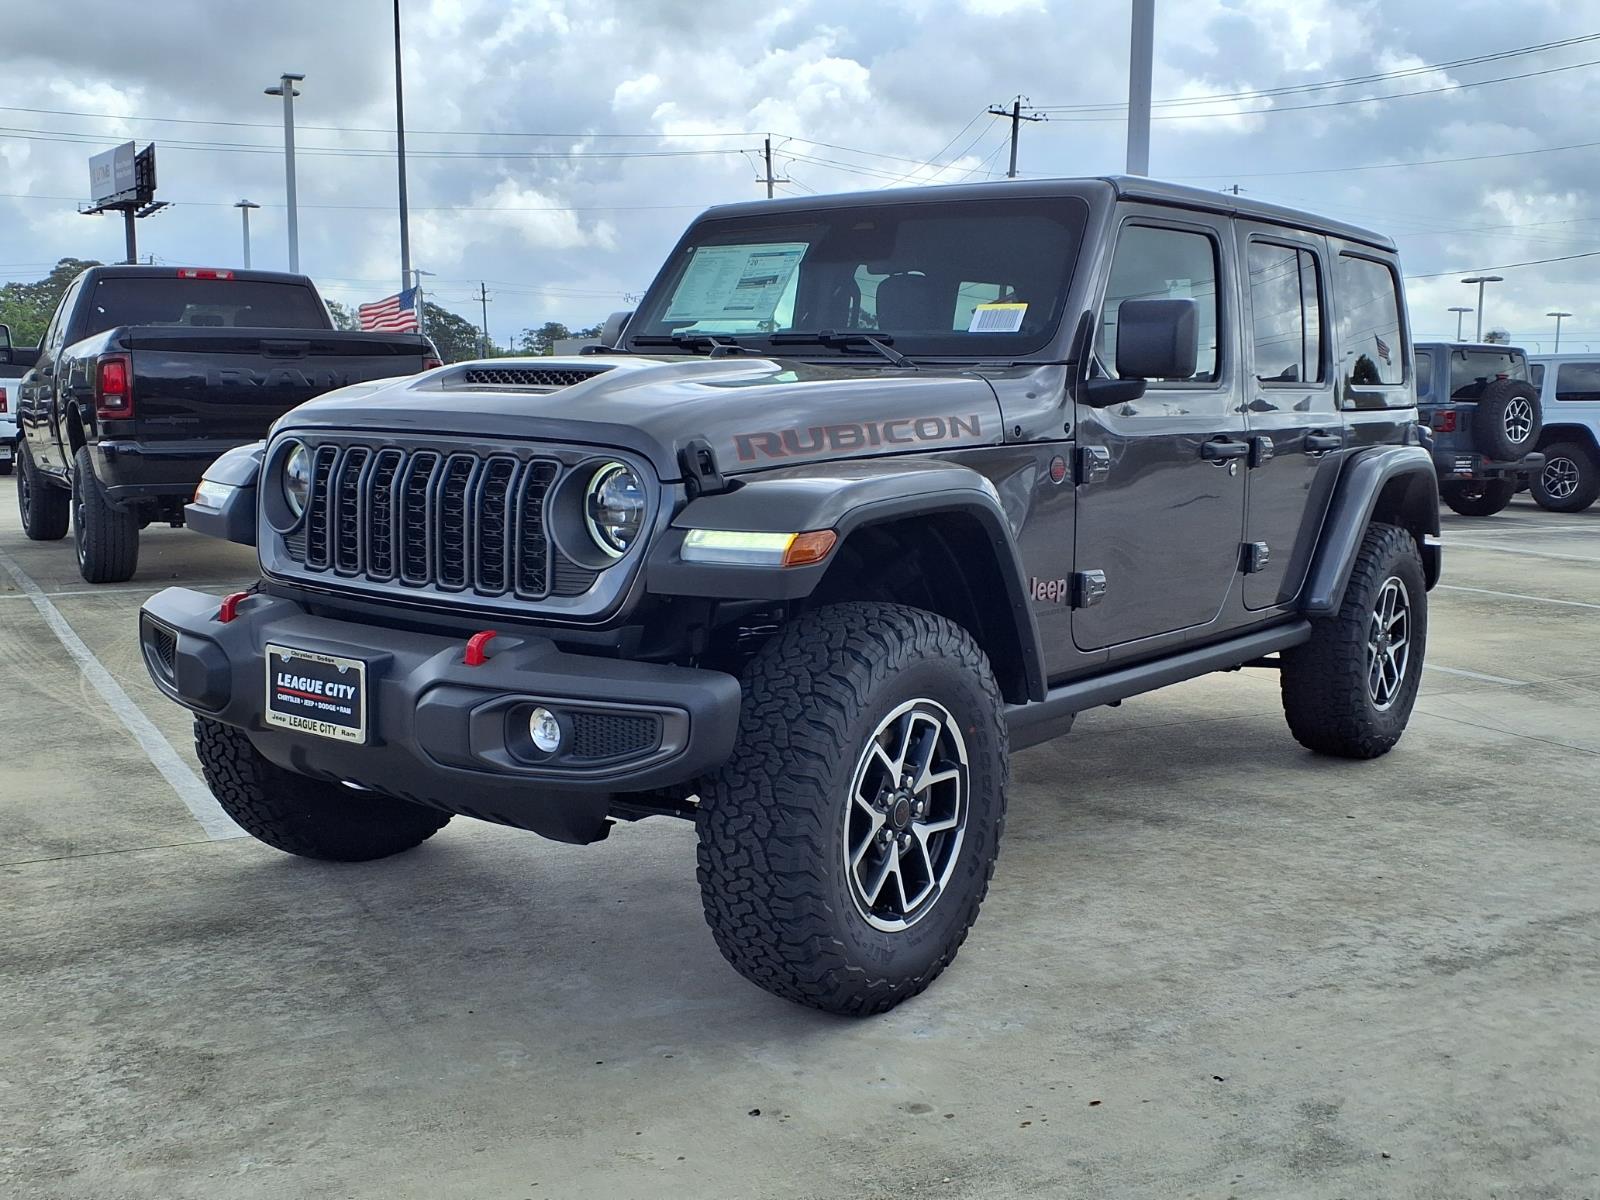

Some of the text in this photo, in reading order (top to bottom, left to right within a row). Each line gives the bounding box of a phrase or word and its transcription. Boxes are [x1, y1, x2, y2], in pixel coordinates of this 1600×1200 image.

[732, 414, 982, 462] RUBICON
[1030, 576, 1067, 603] Jeep
[277, 673, 355, 700] LEAGUE CITY
[318, 702, 336, 711] DODGE
[289, 716, 318, 731] LEAGUE
[320, 724, 337, 736] CITY
[341, 729, 357, 738] Ram
